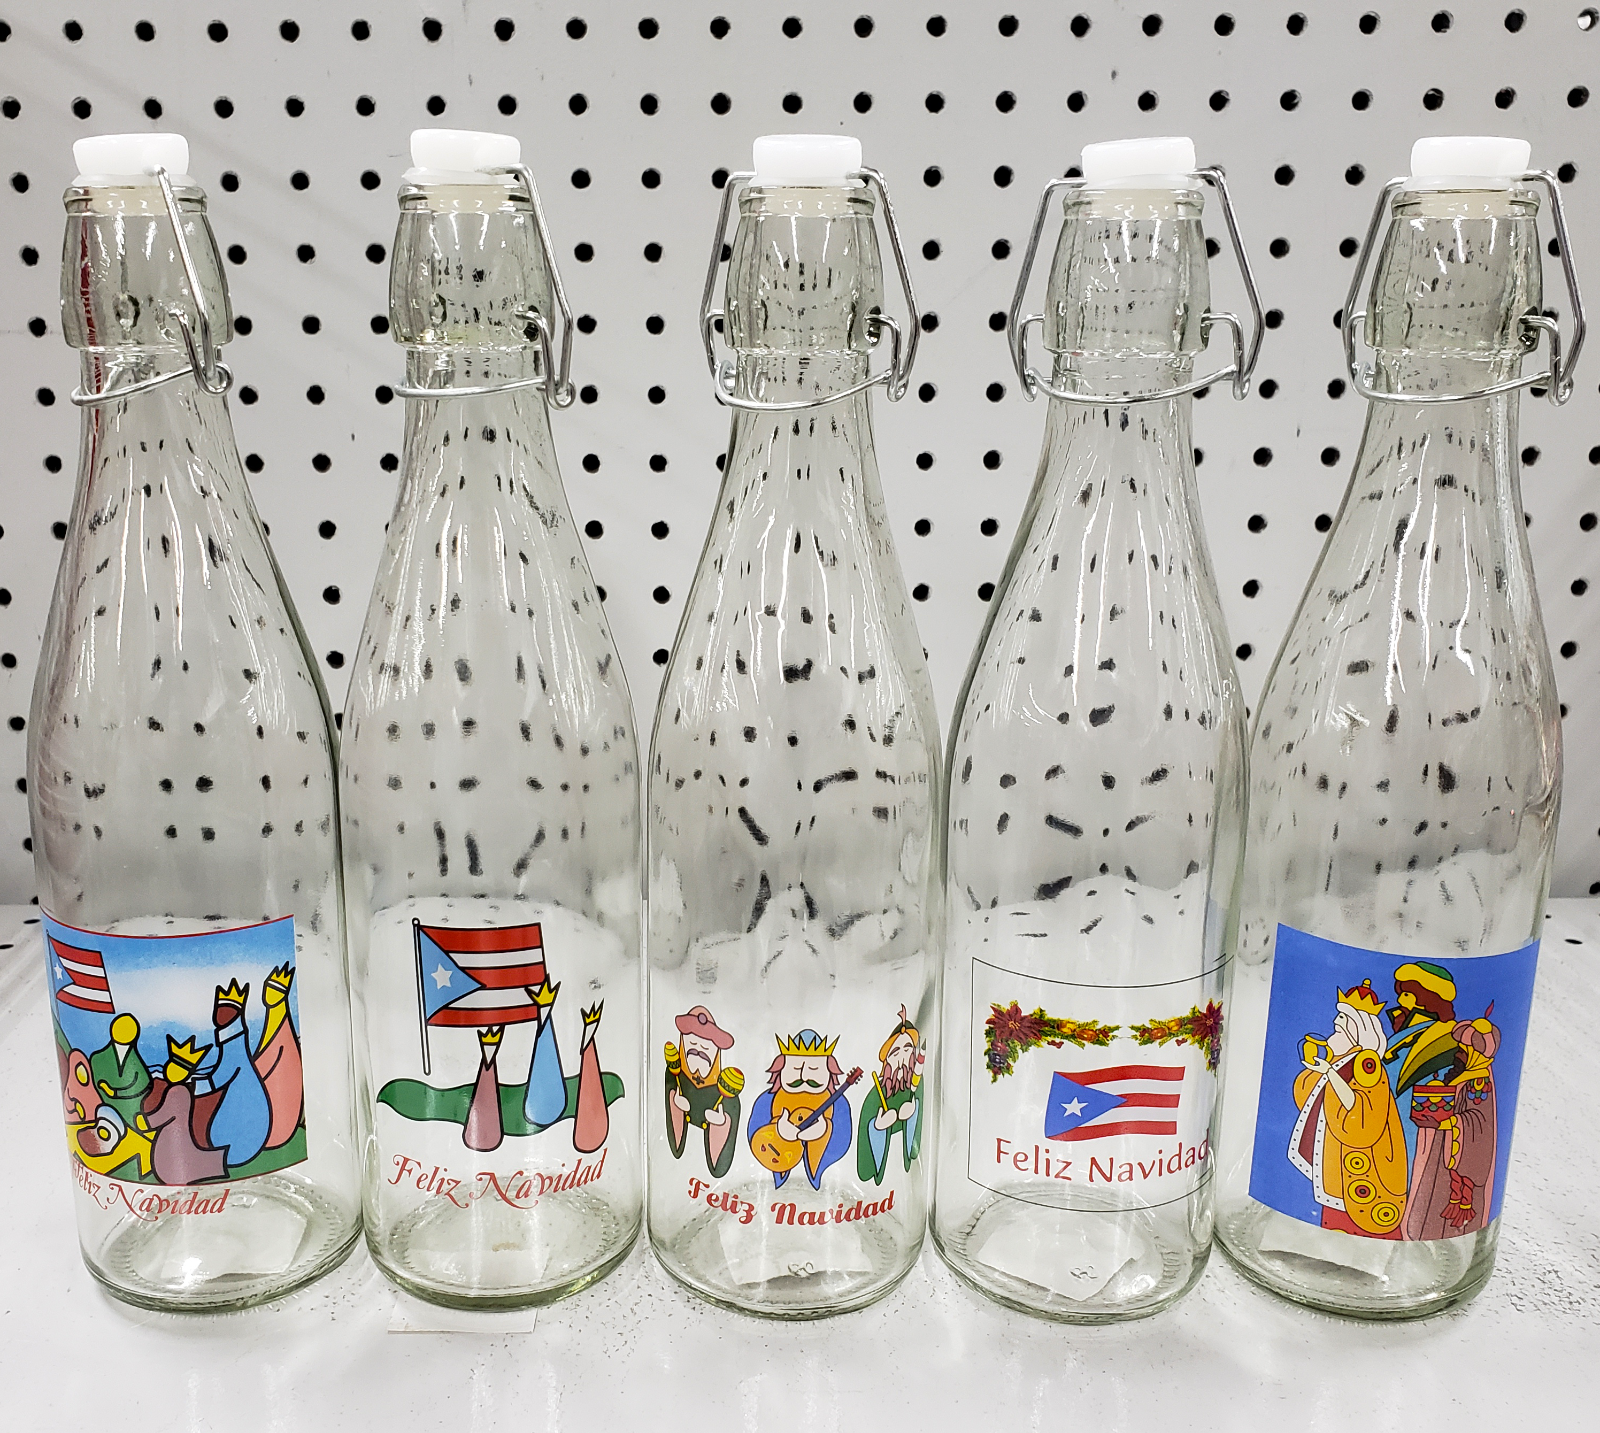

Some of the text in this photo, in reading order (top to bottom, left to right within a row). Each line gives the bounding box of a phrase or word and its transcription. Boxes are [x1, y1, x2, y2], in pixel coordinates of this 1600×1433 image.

[388, 1148, 608, 1210] Feliz Navidad
[996, 1128, 1209, 1183] Feliz Navidad
[73, 1159, 231, 1222] Feliz Navidad
[688, 1177, 895, 1226] Feliz Navidad
